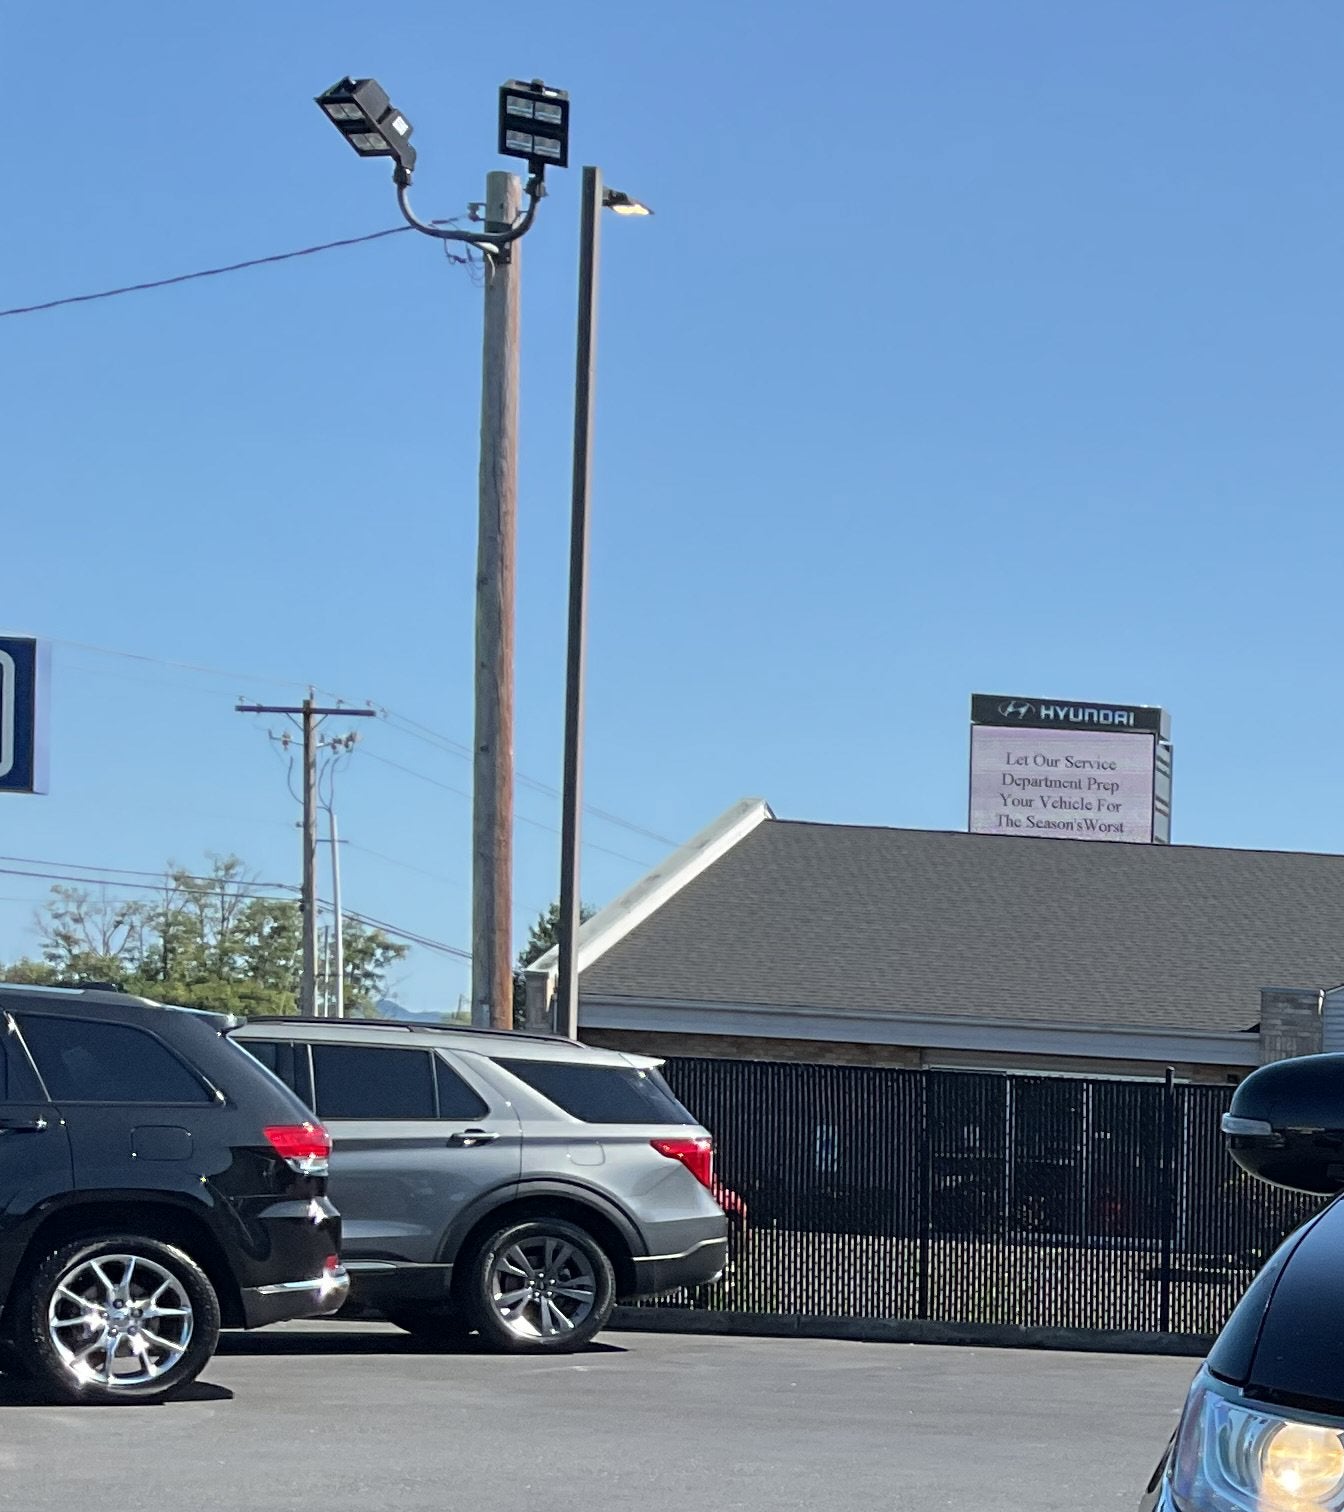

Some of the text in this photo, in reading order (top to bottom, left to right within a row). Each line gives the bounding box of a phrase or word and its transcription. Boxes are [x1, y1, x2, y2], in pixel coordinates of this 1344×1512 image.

[1040, 704, 1135, 727] HYUNDAI
[1006, 752, 1117, 771] Let Our Service
[1002, 773, 1120, 795] Department Prep
[1000, 793, 1122, 813] Your Vehicle For
[996, 814, 1021, 828] The
